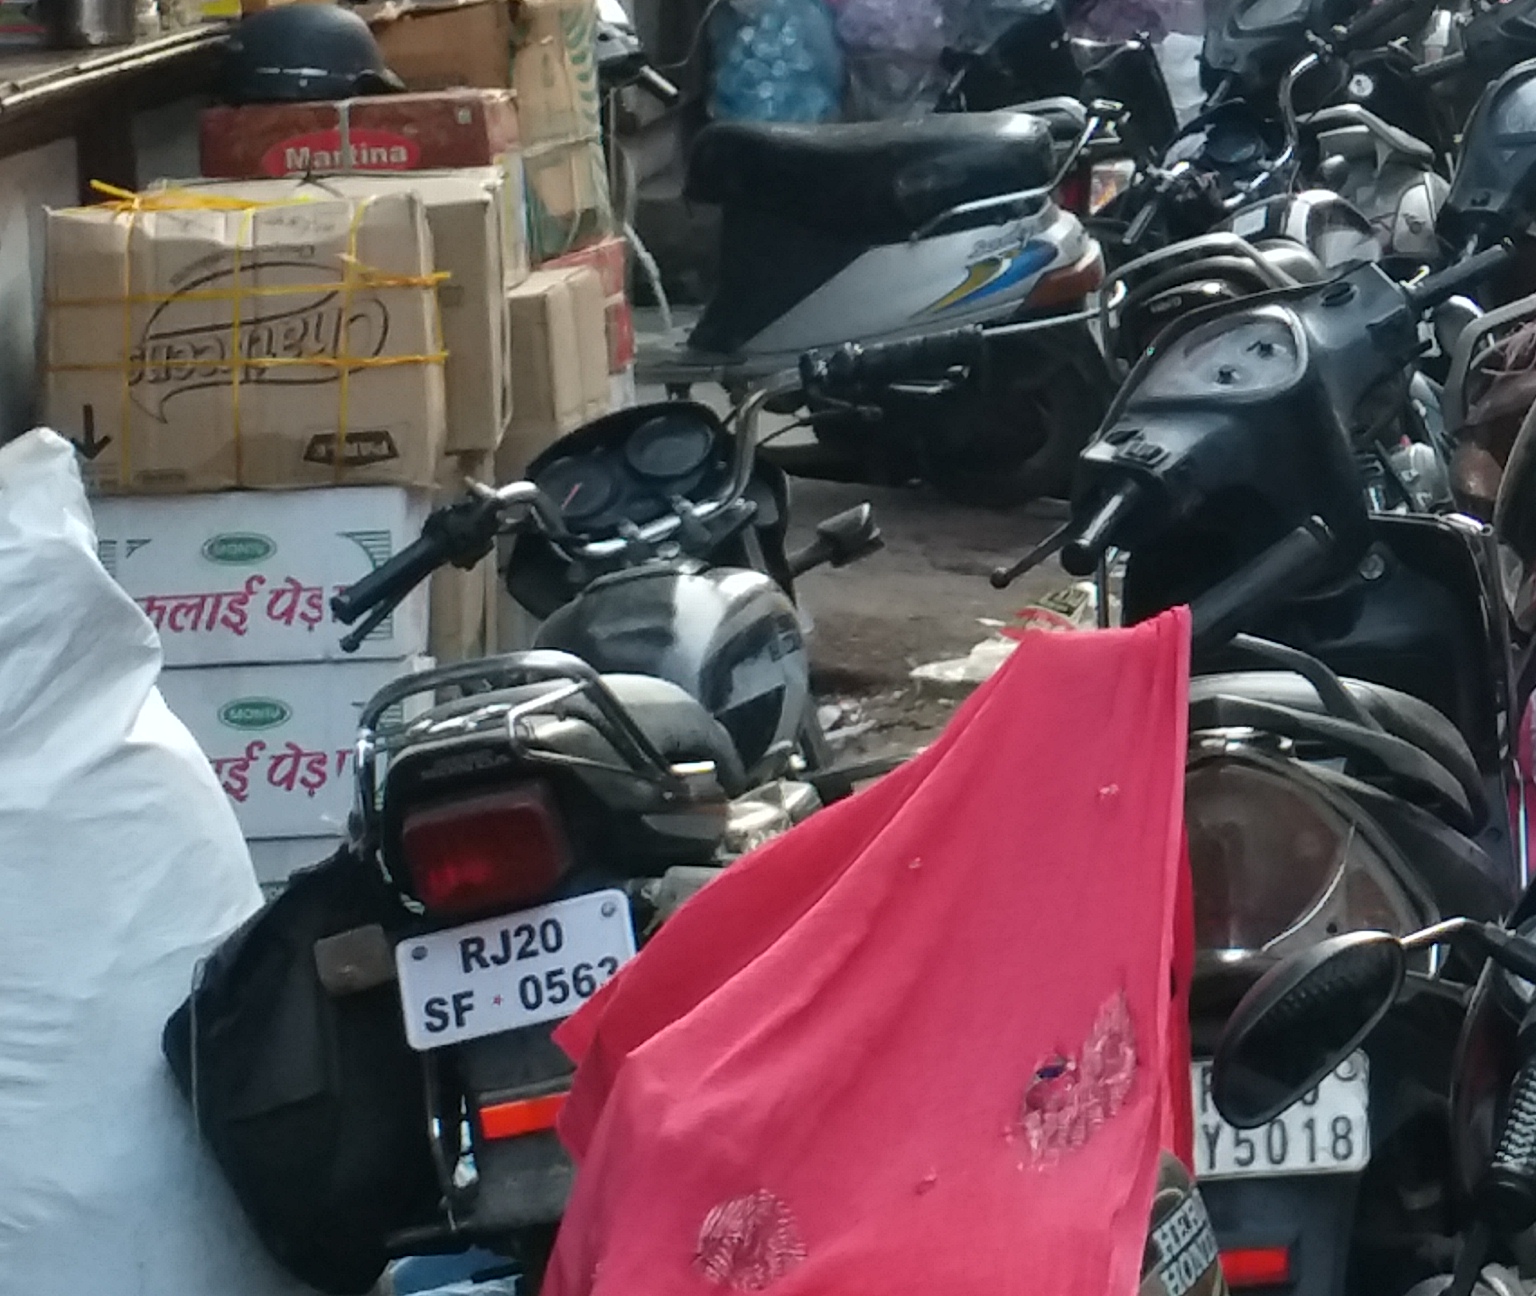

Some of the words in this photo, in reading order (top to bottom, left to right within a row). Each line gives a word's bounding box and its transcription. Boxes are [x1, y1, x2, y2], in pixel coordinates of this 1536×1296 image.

[285, 143, 408, 171] Martina
[458, 917, 564, 974] RJ20
[423, 990, 474, 1034] SF
[1202, 1115, 1354, 1171] Y5018
